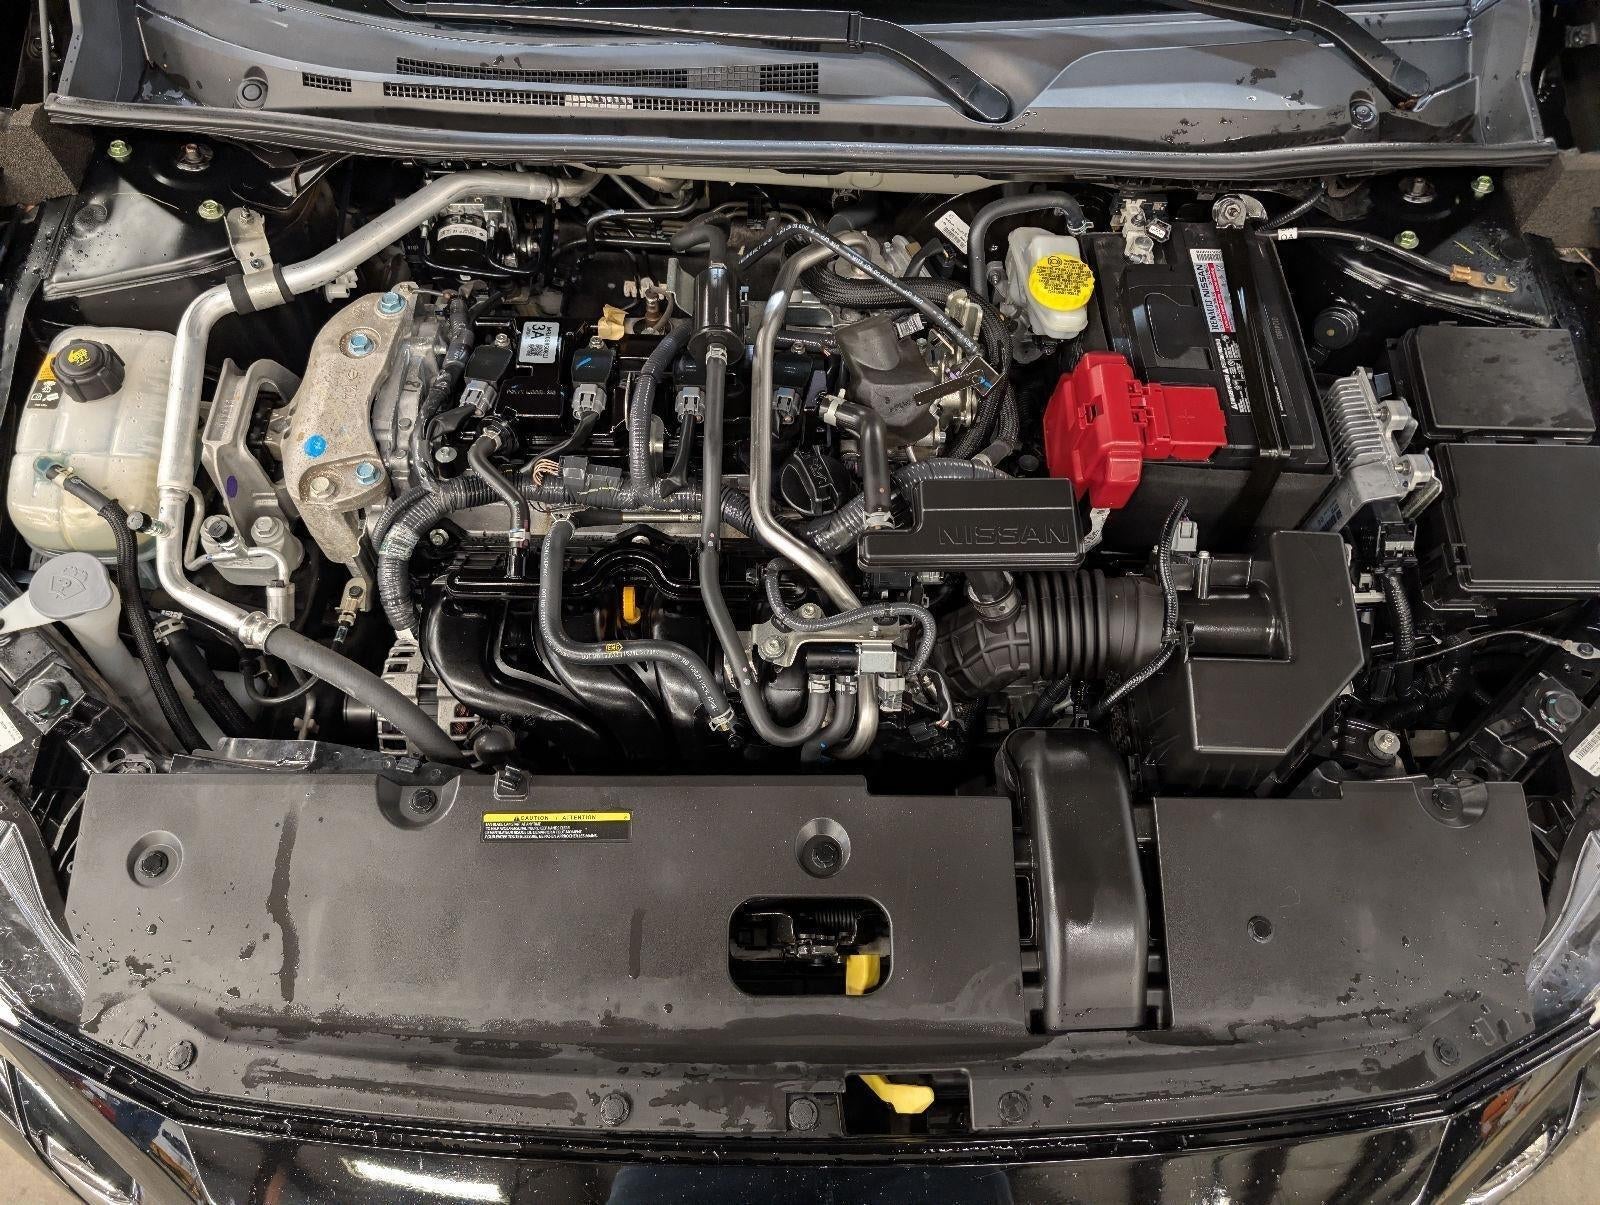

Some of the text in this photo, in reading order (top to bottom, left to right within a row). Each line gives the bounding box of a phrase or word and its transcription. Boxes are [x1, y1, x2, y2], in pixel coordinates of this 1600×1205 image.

[1196, 264, 1210, 297] NISSAN
[1205, 299, 1219, 330] RENAULT
[531, 324, 546, 339] 3A
[938, 524, 1069, 544] NISSAN
